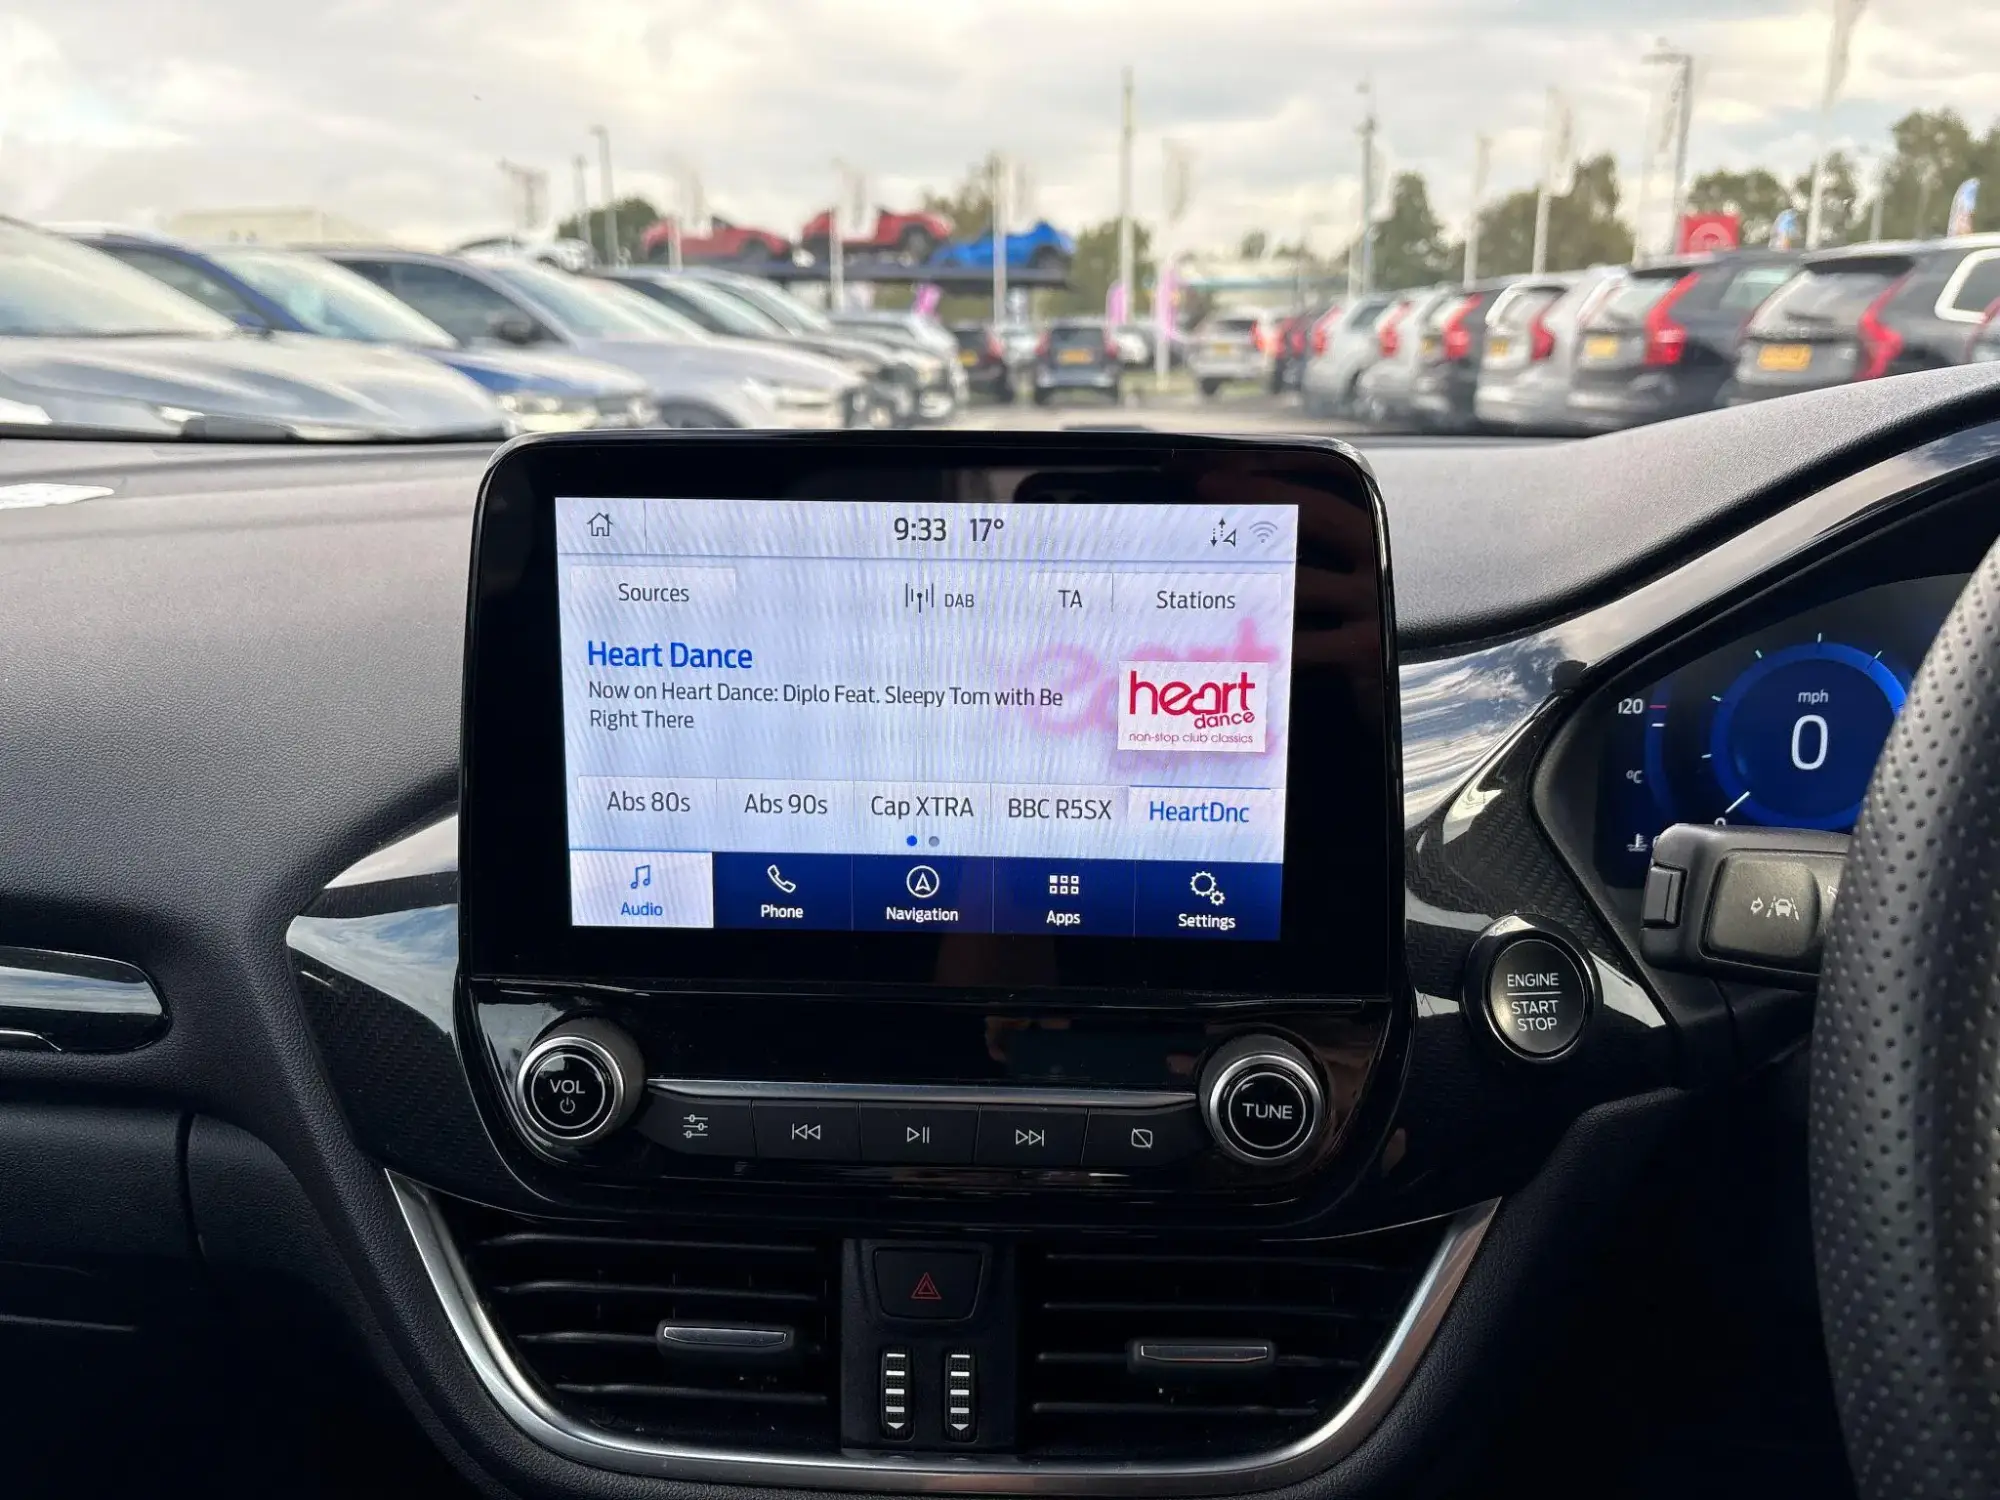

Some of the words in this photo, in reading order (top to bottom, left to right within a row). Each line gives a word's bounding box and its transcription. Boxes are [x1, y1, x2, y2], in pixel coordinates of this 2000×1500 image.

[893, 517, 947, 541] 9:33
[617, 583, 690, 602] Sources
[944, 593, 975, 608] DAB
[1058, 589, 1083, 608] TA
[1156, 589, 1236, 610] Stations
[587, 641, 662, 668] Heart
[670, 643, 753, 669] Dance
[588, 682, 630, 699] Now
[634, 685, 657, 700] on
[661, 682, 712, 701] Heart
[717, 684, 778, 702] Dance:
[783, 685, 830, 706] Diplo
[835, 686, 880, 704] Feat.
[885, 686, 945, 707] Sleepy
[949, 687, 990, 706] Tom
[994, 688, 1034, 707] with
[1040, 690, 1063, 707] Be
[1129, 670, 1256, 716] heart
[1798, 689, 1829, 703] mph
[1618, 698, 1644, 714] 120
[590, 710, 637, 731] Right
[641, 712, 695, 730] There
[1194, 709, 1255, 729] dance
[1129, 732, 1179, 743] non-stop
[1182, 731, 1207, 743] club
[1210, 733, 1253, 743] classics
[1791, 714, 1829, 770] 0
[607, 791, 646, 812] Abs
[652, 793, 691, 812] 80s
[744, 794, 783, 814] Abs
[788, 795, 828, 815] 90s
[871, 796, 909, 819] Cap
[916, 796, 974, 817] XTRA
[1008, 798, 1050, 818] BBC
[1056, 799, 1112, 820] R5SX
[1150, 801, 1249, 823] HeartDnc
[620, 902, 663, 917] Audio
[760, 904, 804, 919] Phone
[886, 906, 959, 924] Navigation
[1046, 910, 1081, 926] Apps
[1178, 913, 1236, 931] Settings
[1507, 973, 1560, 987] ENGINE
[1511, 1000, 1559, 1015] START
[1518, 1017, 1557, 1031] STOP
[550, 1079, 585, 1094] VOL
[1242, 1102, 1293, 1119] TUNE
